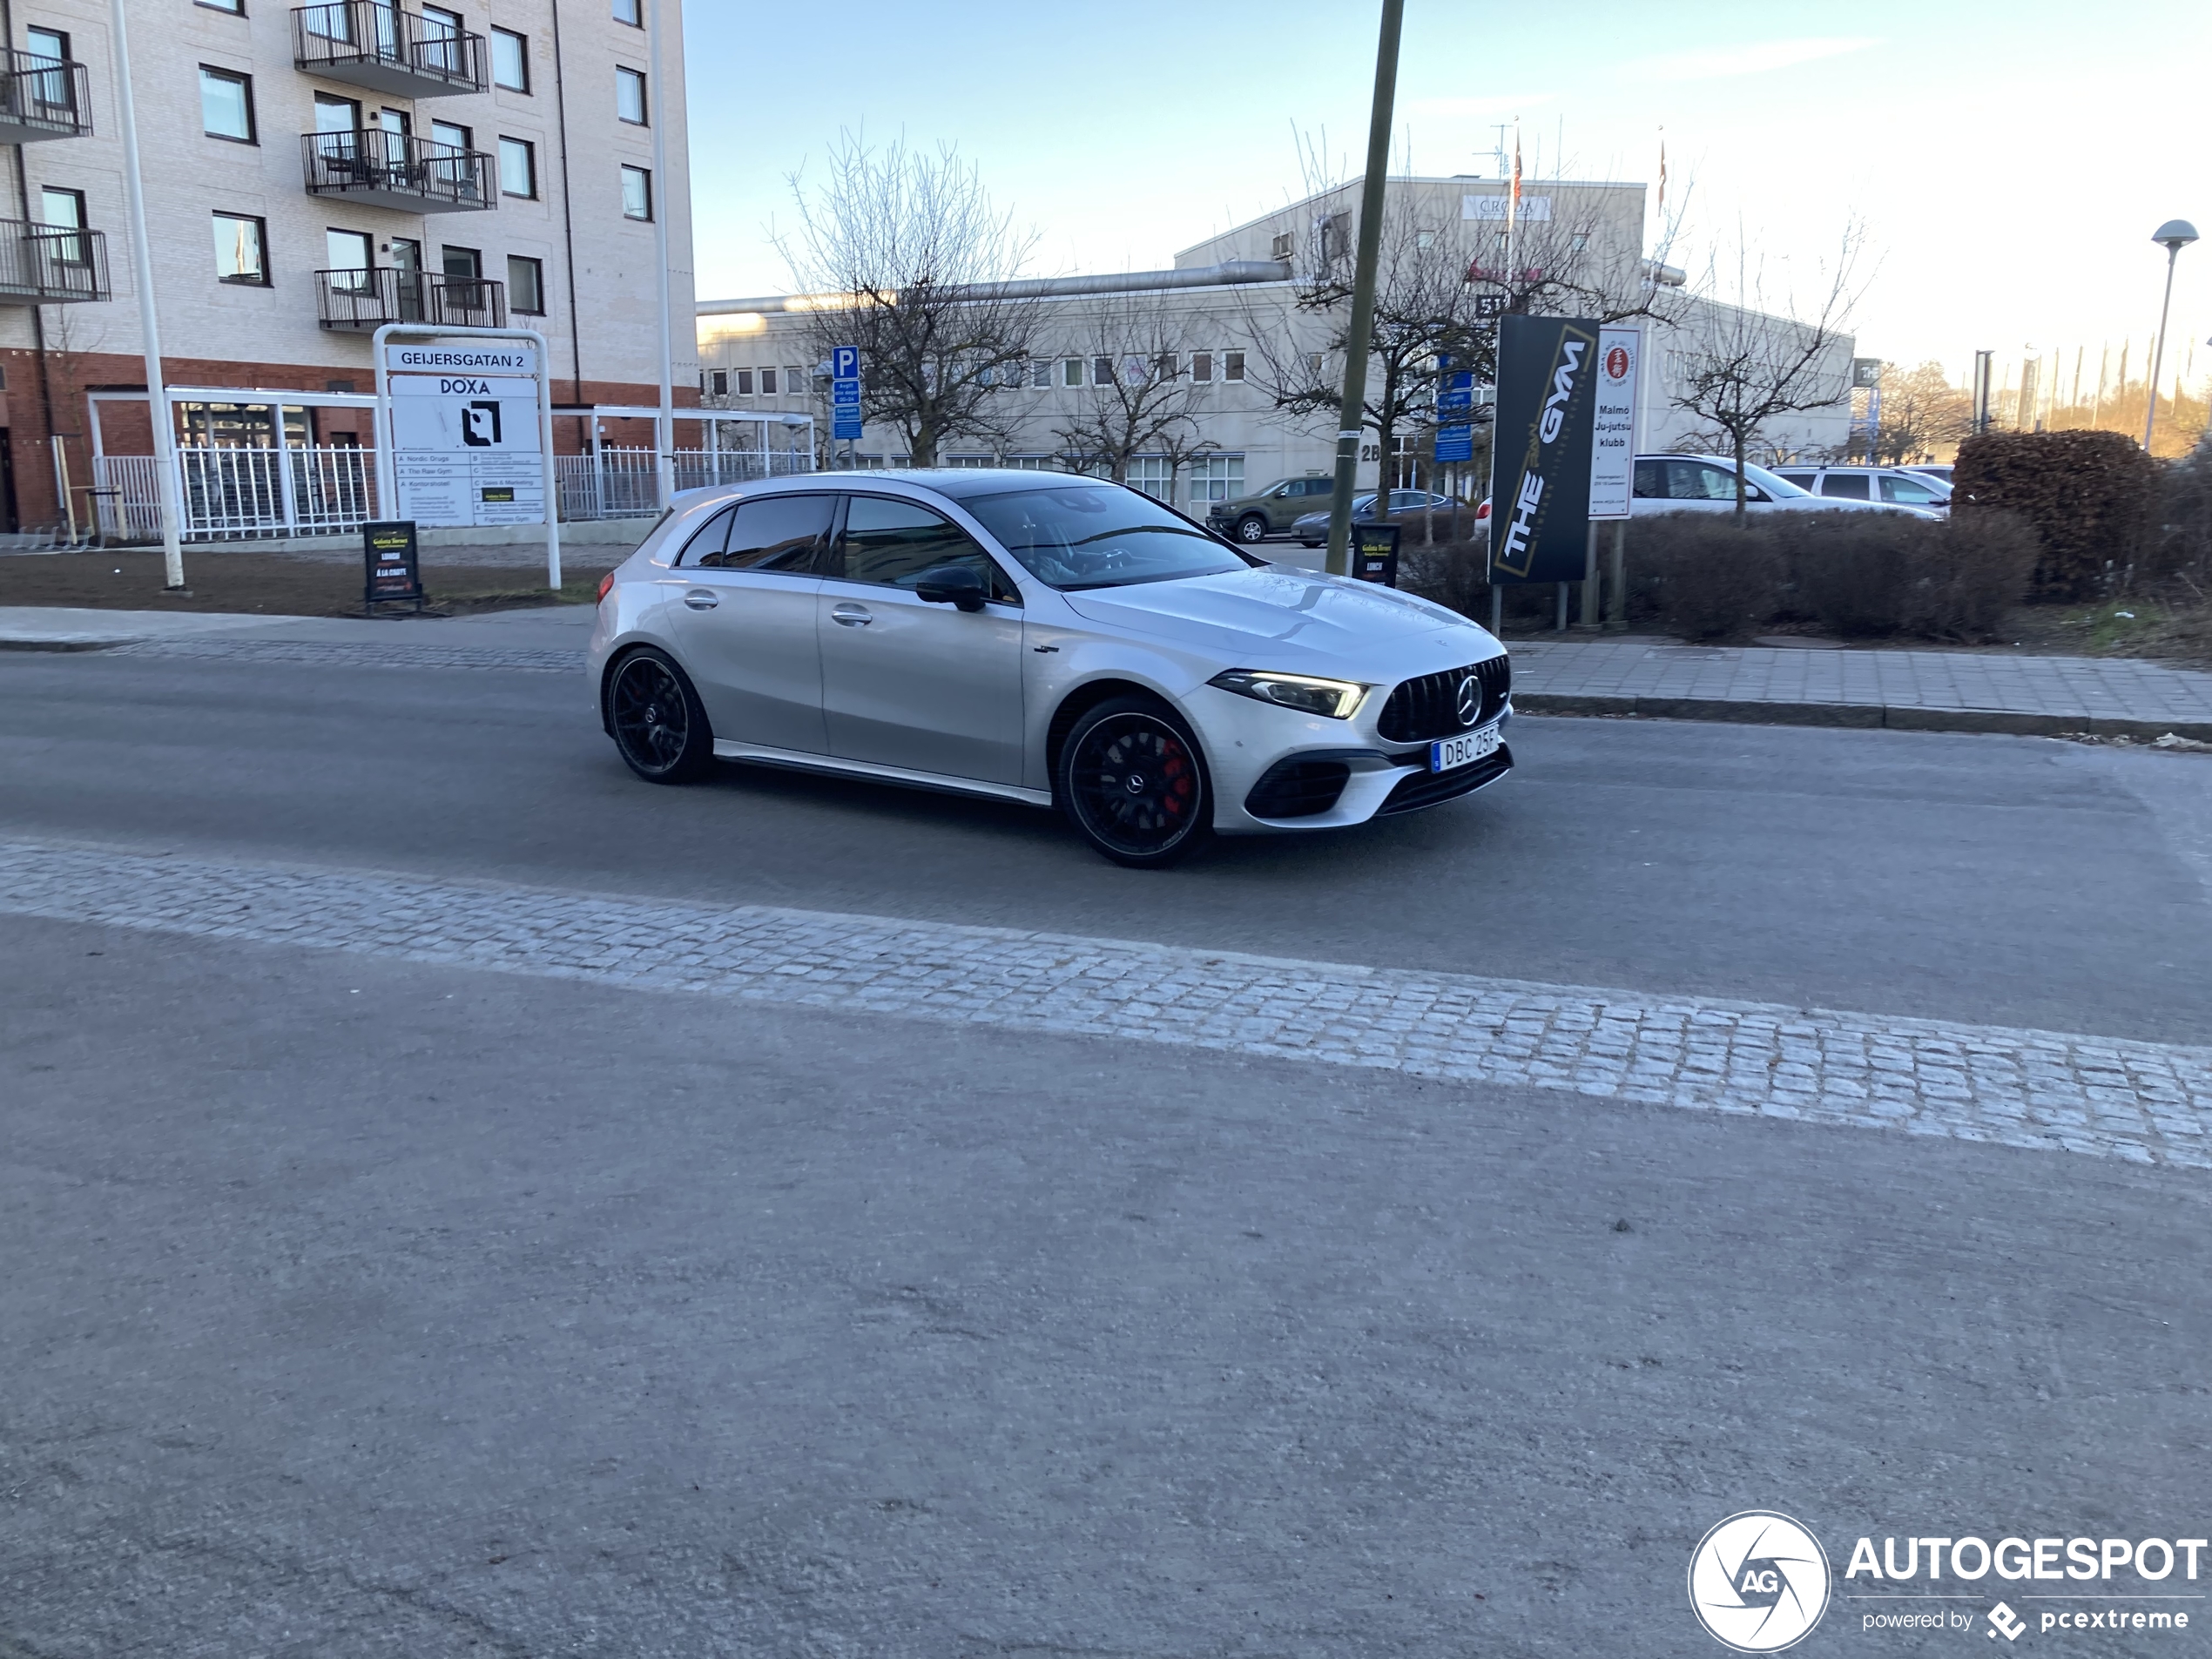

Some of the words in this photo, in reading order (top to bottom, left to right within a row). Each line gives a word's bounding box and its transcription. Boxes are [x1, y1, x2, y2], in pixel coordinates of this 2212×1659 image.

[401, 352, 512, 367] GEIJERSGATAN
[516, 356, 524, 367] 2
[839, 349, 854, 376] P
[441, 379, 491, 395] DOXA
[1599, 405, 1629, 415] Malmö
[1595, 421, 1632, 433] Ju-jutsu
[1504, 470, 1544, 557] THE
[1540, 341, 1585, 443] GYM
[1599, 438, 1625, 447] klubb
[1362, 444, 1380, 462] 2B
[1446, 738, 1473, 765] DBC
[1476, 728, 1494, 756] 25F
